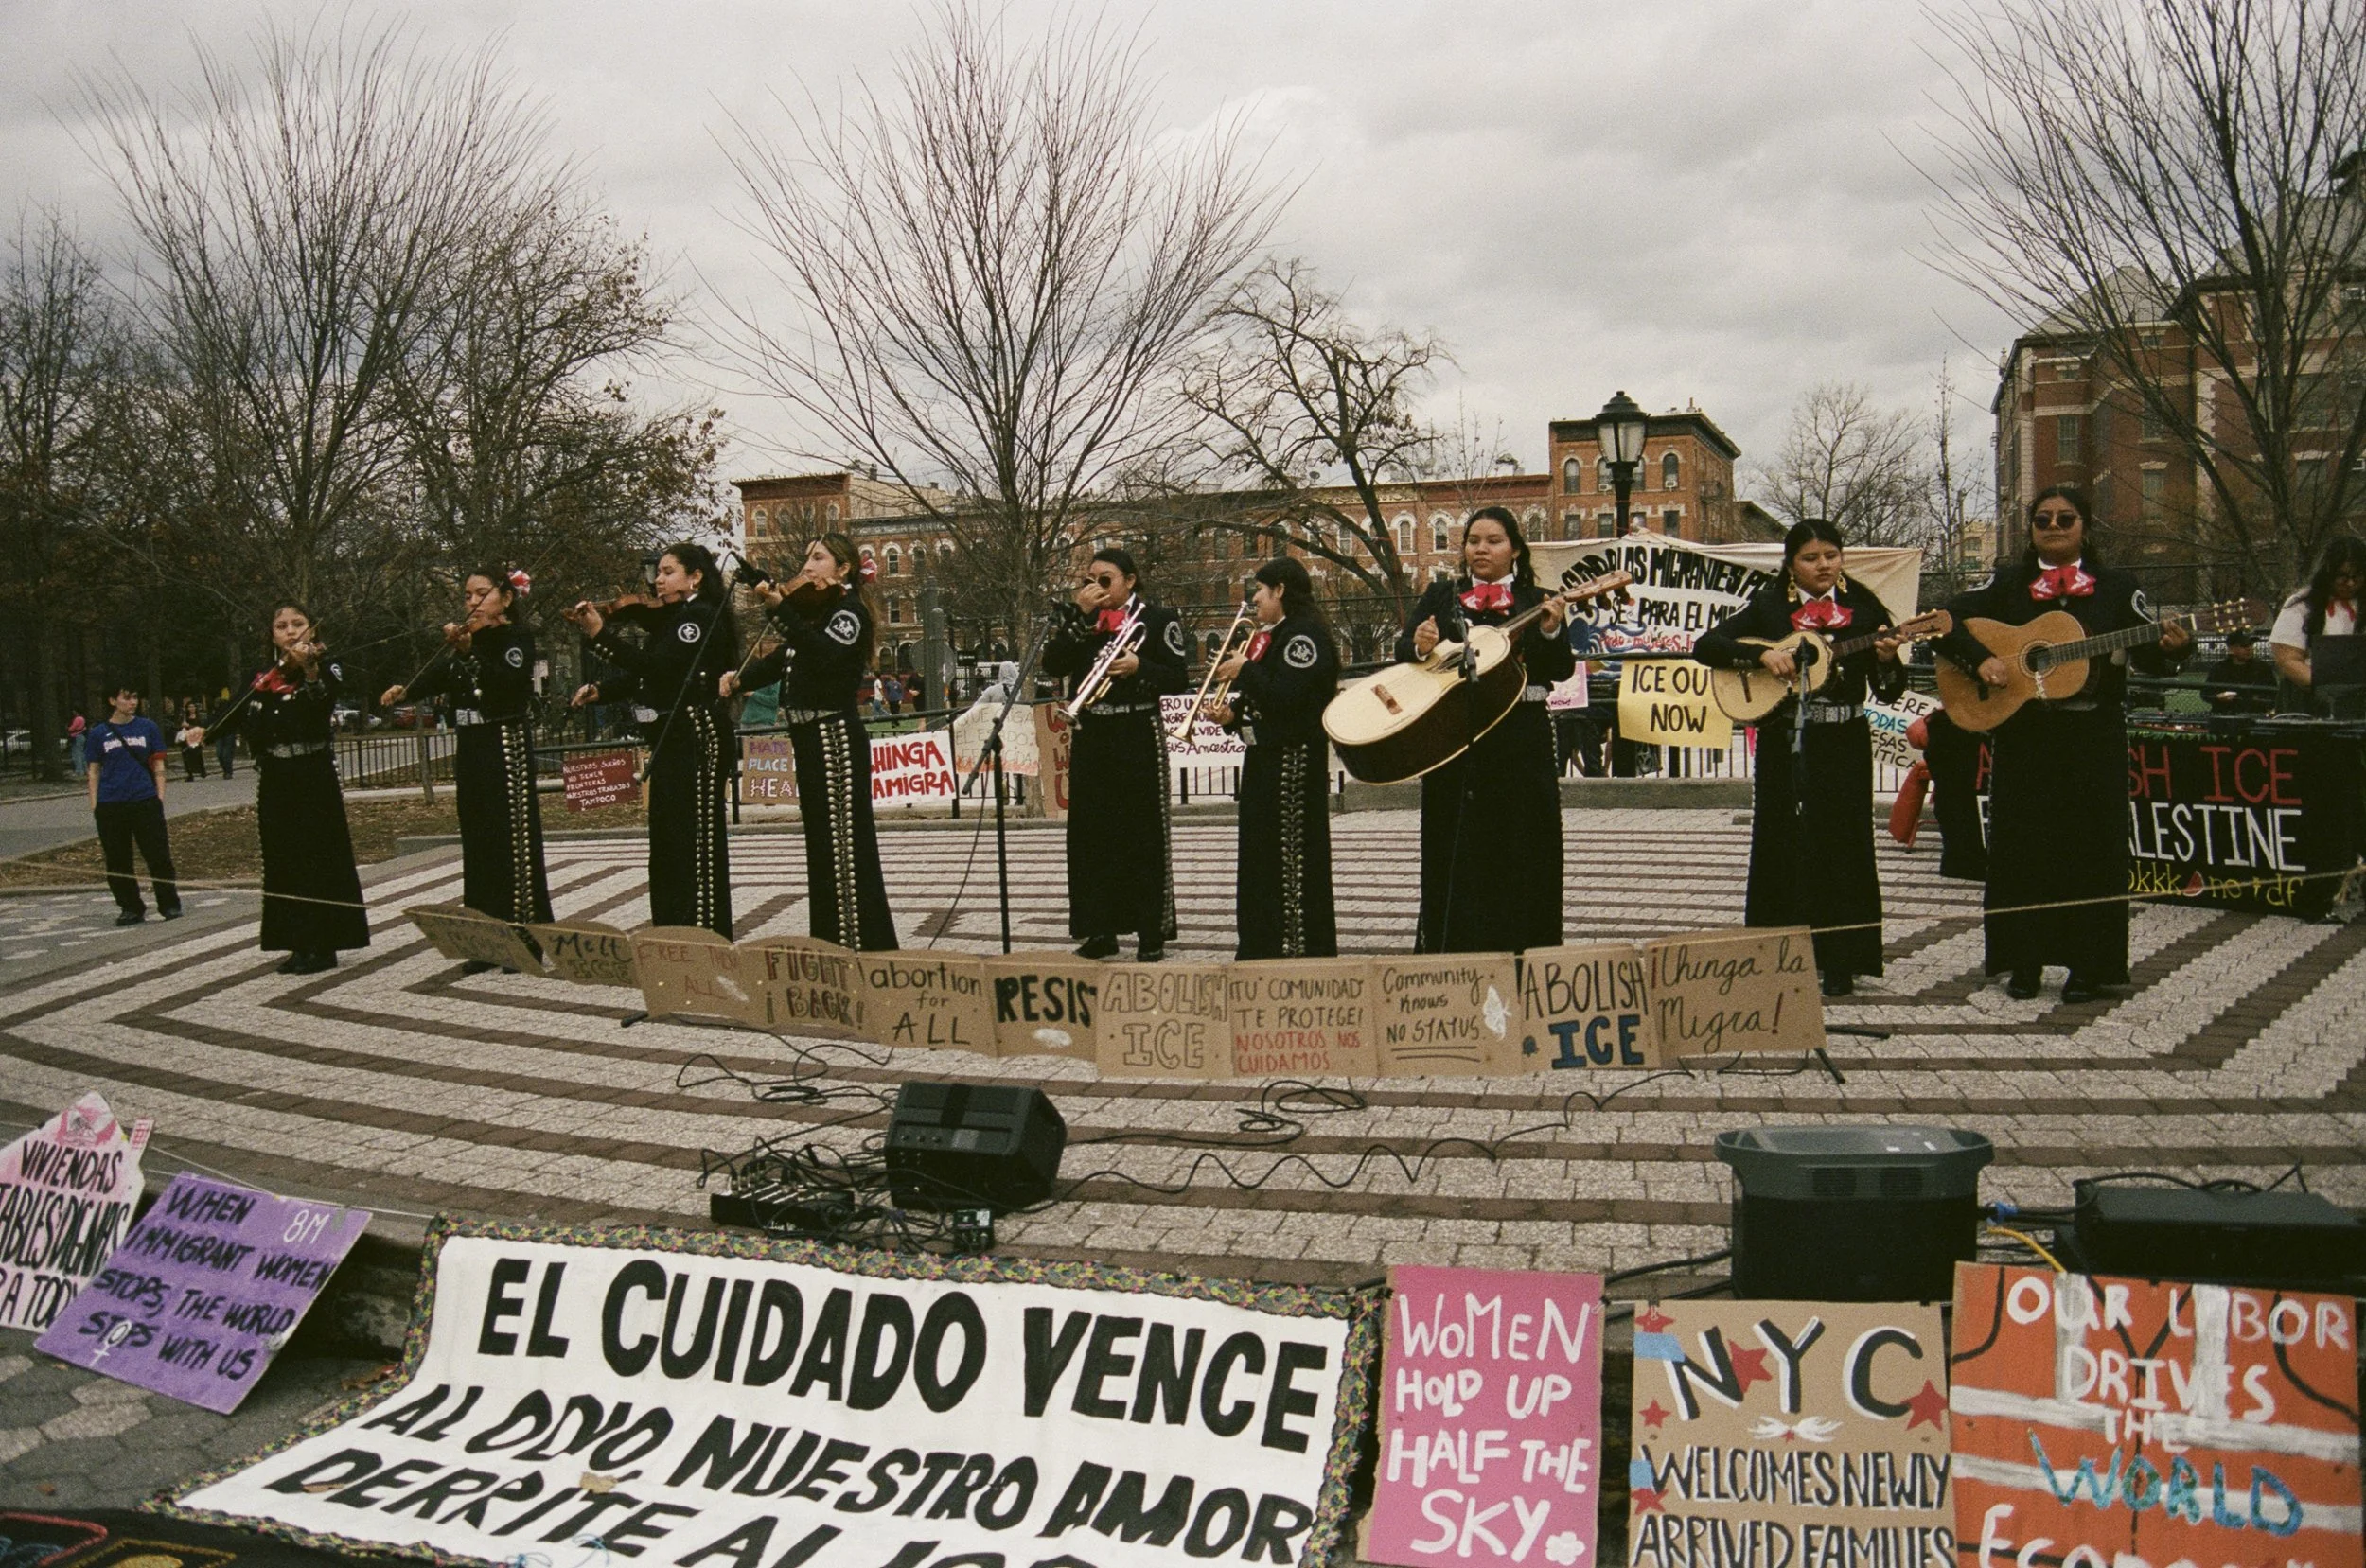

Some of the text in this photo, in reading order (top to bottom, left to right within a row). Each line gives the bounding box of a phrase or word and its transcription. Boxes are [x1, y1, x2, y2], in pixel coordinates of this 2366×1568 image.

[1638, 597, 1679, 628] PARA
[1684, 601, 1704, 631] EL
[1632, 664, 1709, 696] ICE OU
[1192, 725, 1222, 736] LVIDE
[1651, 703, 1706, 733] NOW
[871, 741, 946, 774] HINGA
[1871, 729, 1908, 752] ESAS
[748, 758, 788, 772] PLACE
[2200, 746, 2303, 804] ICE
[579, 794, 616, 806] TAMPOCO
[597, 782, 630, 793] TRABAJOS
[750, 778, 799, 798] HEA
[2128, 802, 2305, 872] LESTINE
[636, 942, 693, 967] FREE
[764, 945, 850, 991] FIGHT
[1775, 935, 1809, 974] la
[684, 975, 729, 1000] ALL
[870, 961, 981, 995] abortion
[1103, 972, 1227, 1022] ABOLISH
[1268, 978, 1364, 1001] COMUNIDAD
[1383, 967, 1483, 1007] Community
[1525, 960, 1649, 1021] ABOLISH
[916, 991, 949, 1010] for
[995, 975, 1097, 1028] RESIS
[1234, 1007, 1265, 1029] TE
[892, 1012, 970, 1046] ALL
[1122, 1019, 1205, 1069] ICE
[1235, 1030, 1361, 1053] NOSOTROS NOS
[1386, 1023, 1406, 1045] NO
[1548, 1014, 1645, 1069] ICE
[1237, 1051, 1330, 1074] CUIDAMOS
[21, 1140, 123, 1194] VIVIENDAS
[166, 1185, 256, 1225] WHEN
[284, 1209, 330, 1244] 8M
[125, 1225, 339, 1293] IMMIGRANT WOMEN
[22, 1275, 78, 1330] TOD
[174, 1289, 226, 1321] THE
[221, 1302, 296, 1337] WORLD
[2006, 1276, 2350, 1351] OUR LBOR
[158, 1334, 220, 1369] WITH
[216, 1348, 256, 1382] US
[477, 1259, 1329, 1453] EL CUIDADO VENCE
[1663, 1315, 1924, 1421] NYC
[1395, 1369, 1572, 1419] HOLD UP
[359, 1383, 484, 1442] AL
[665, 1414, 1038, 1531] NUESTRO
[1035, 1462, 1316, 1565] AMOR
[1386, 1429, 1592, 1494] HALF THE
[1639, 1444, 1951, 1511] WELCOMES NEWLY
[2027, 1427, 2304, 1538] WORLD
[262, 1448, 704, 1558] DERRITE
[1410, 1489, 1552, 1563] SKY
[1630, 1514, 1795, 1568] ARRIVED
[1800, 1524, 1957, 1568] FAMILIES
